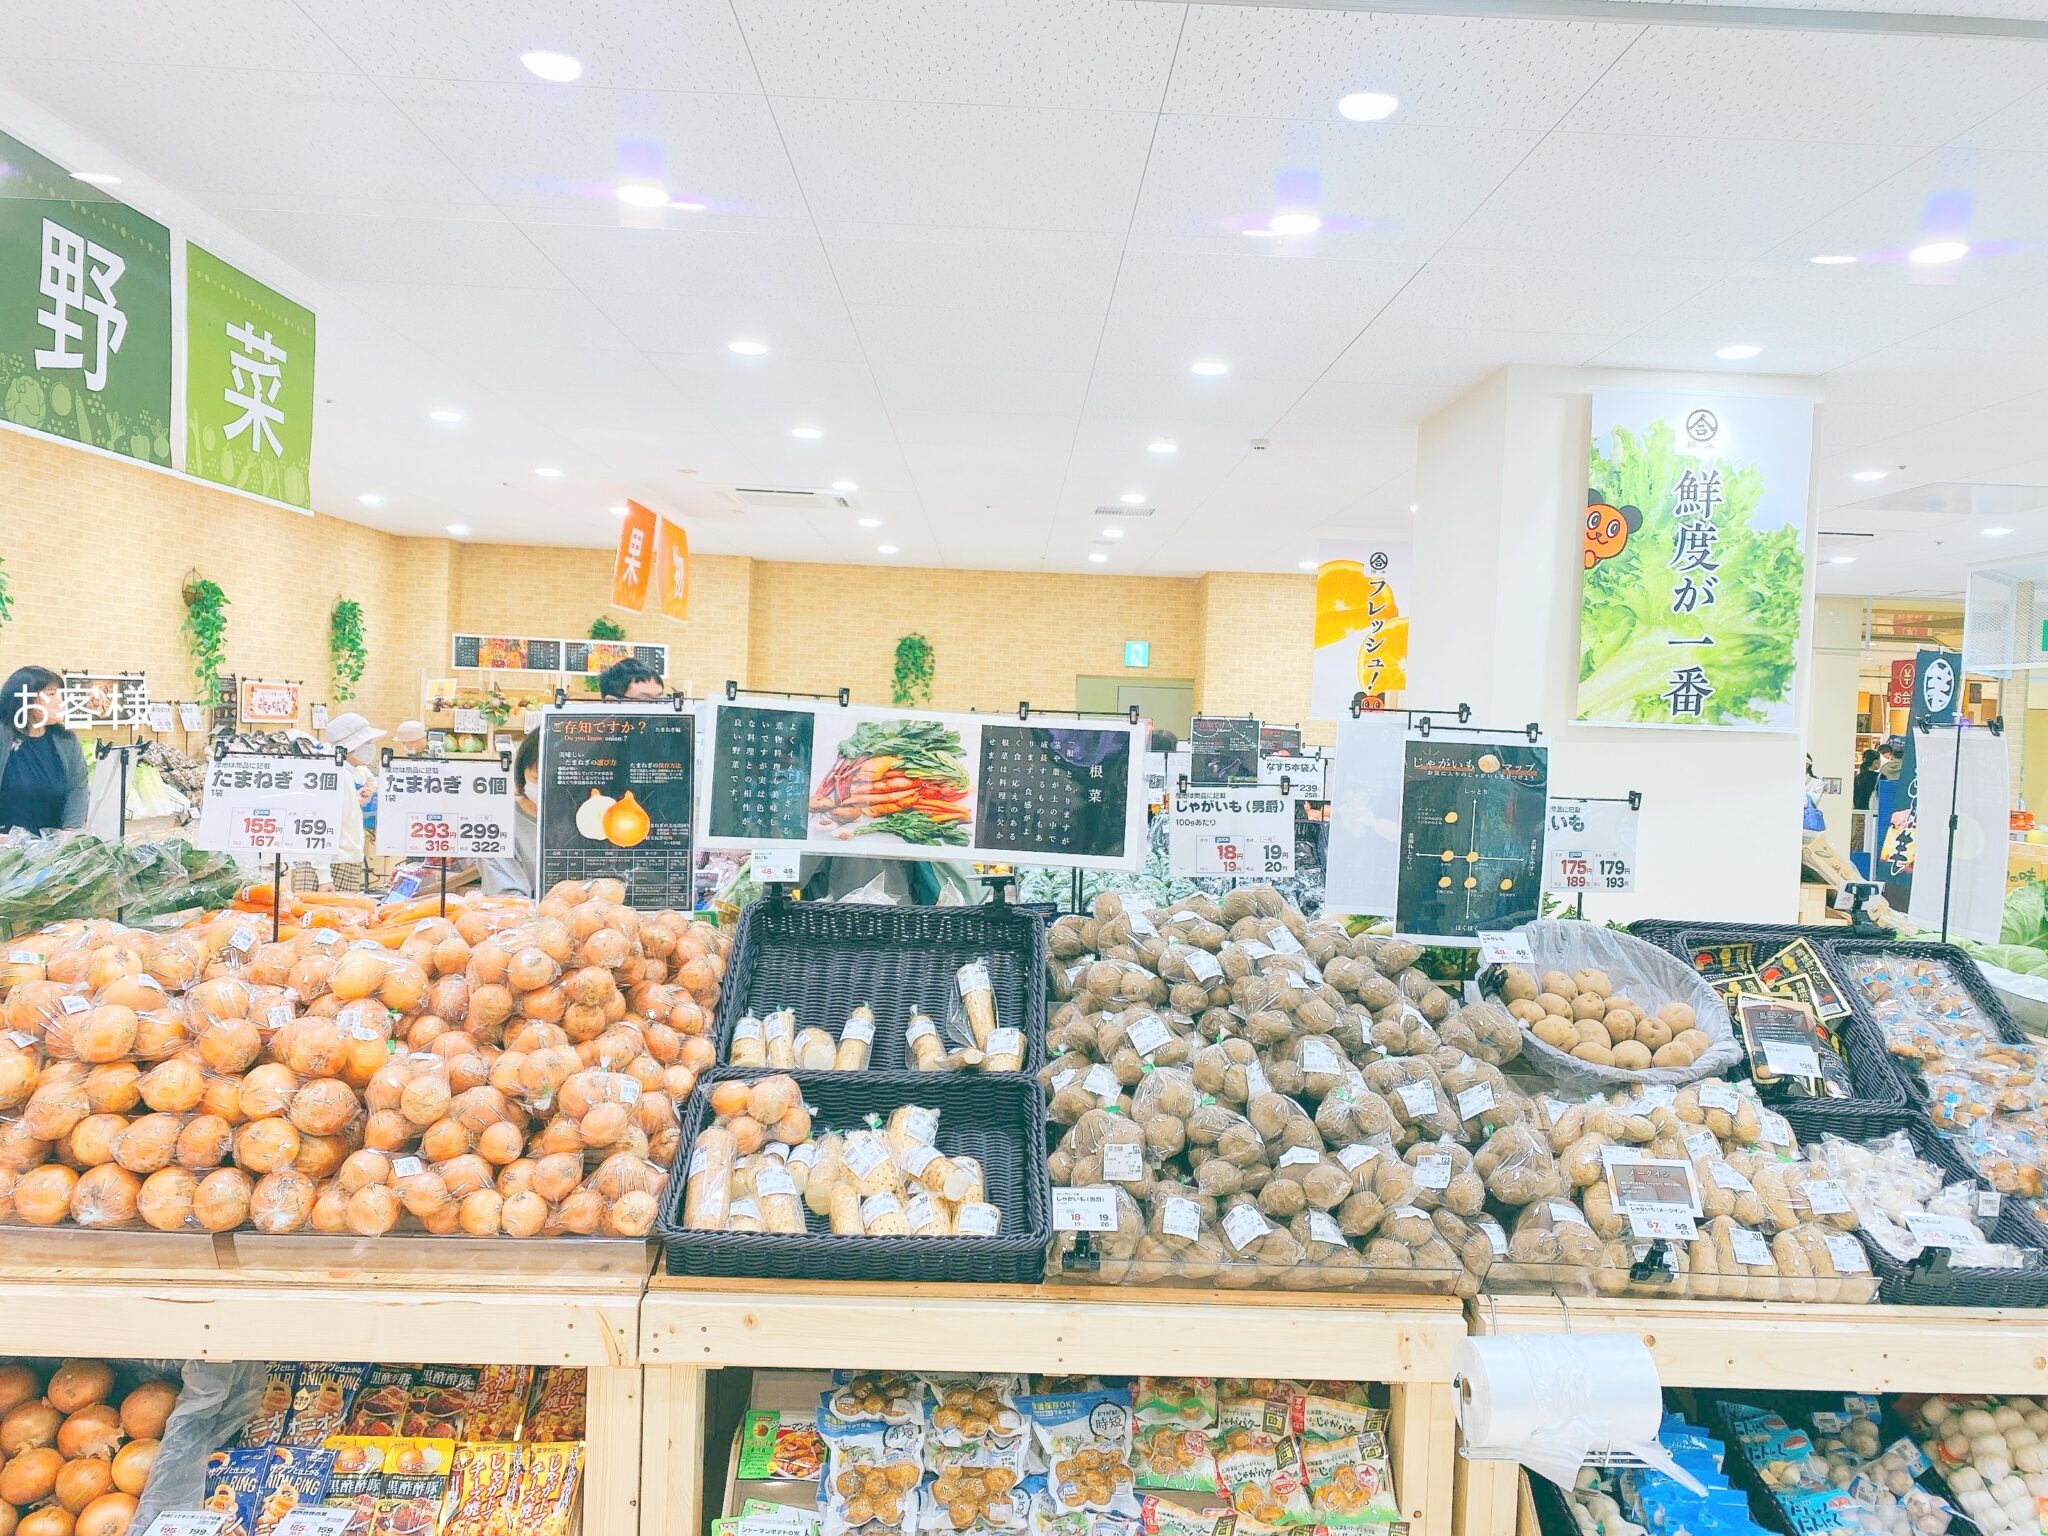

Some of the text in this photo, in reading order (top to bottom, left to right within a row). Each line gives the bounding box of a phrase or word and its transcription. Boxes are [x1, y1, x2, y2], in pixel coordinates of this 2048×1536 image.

[34, 217, 287, 458] 野 菜
[622, 528, 644, 587] 果
[1662, 469, 1723, 716] 鮮度が一番
[1365, 580, 1386, 690] フレッシュ！
[552, 720, 647, 734] ご存知ですか？
[730, 719, 742, 801] 良い野菜です。
[986, 740, 996, 790] せません。
[1266, 763, 1318, 773] なす5本袋入
[1413, 756, 1537, 772] じゃがいも マップ
[212, 770, 338, 791] たまねぎ 3個
[742, 720, 756, 825] な料理との相性が
[756, 721, 770, 825] いですが実は色々
[769, 721, 783, 826] 煮物料理も美味し
[1426, 771, 1536, 781] お気に入りのじゃがいもを見つけよう
[211, 789, 223, 797] 1袋
[385, 775, 507, 795] たまねぎ 6個
[996, 739, 1009, 840] 根菜は料理に欠か
[1010, 740, 1022, 841] く食べ応えのある
[1023, 741, 1035, 836] ります。食感がよ
[1035, 741, 1048, 842] 成長するものもあ
[1049, 741, 1062, 843] 茎や葉が土の中で
[1061, 741, 1075, 845] 「根」とありますが
[1088, 764, 1103, 803] 根菜
[384, 794, 396, 802] 1袋
[1175, 800, 1285, 813] じゃがいも（男爵）
[1175, 818, 1216, 827] 100gあたり
[1551, 814, 1585, 832] いも
[1628, 1169, 1671, 1178] メークイン
[1099, 1213, 1109, 1221] 19
[299, 1371, 334, 1386] ONION
[1095, 1415, 1122, 1431] 時短
[230, 1476, 257, 1493] RING
[294, 1477, 321, 1496] RING
[329, 1478, 381, 1494] 黒酢酢豚
[385, 1480, 439, 1497] 黒酢酢豚
